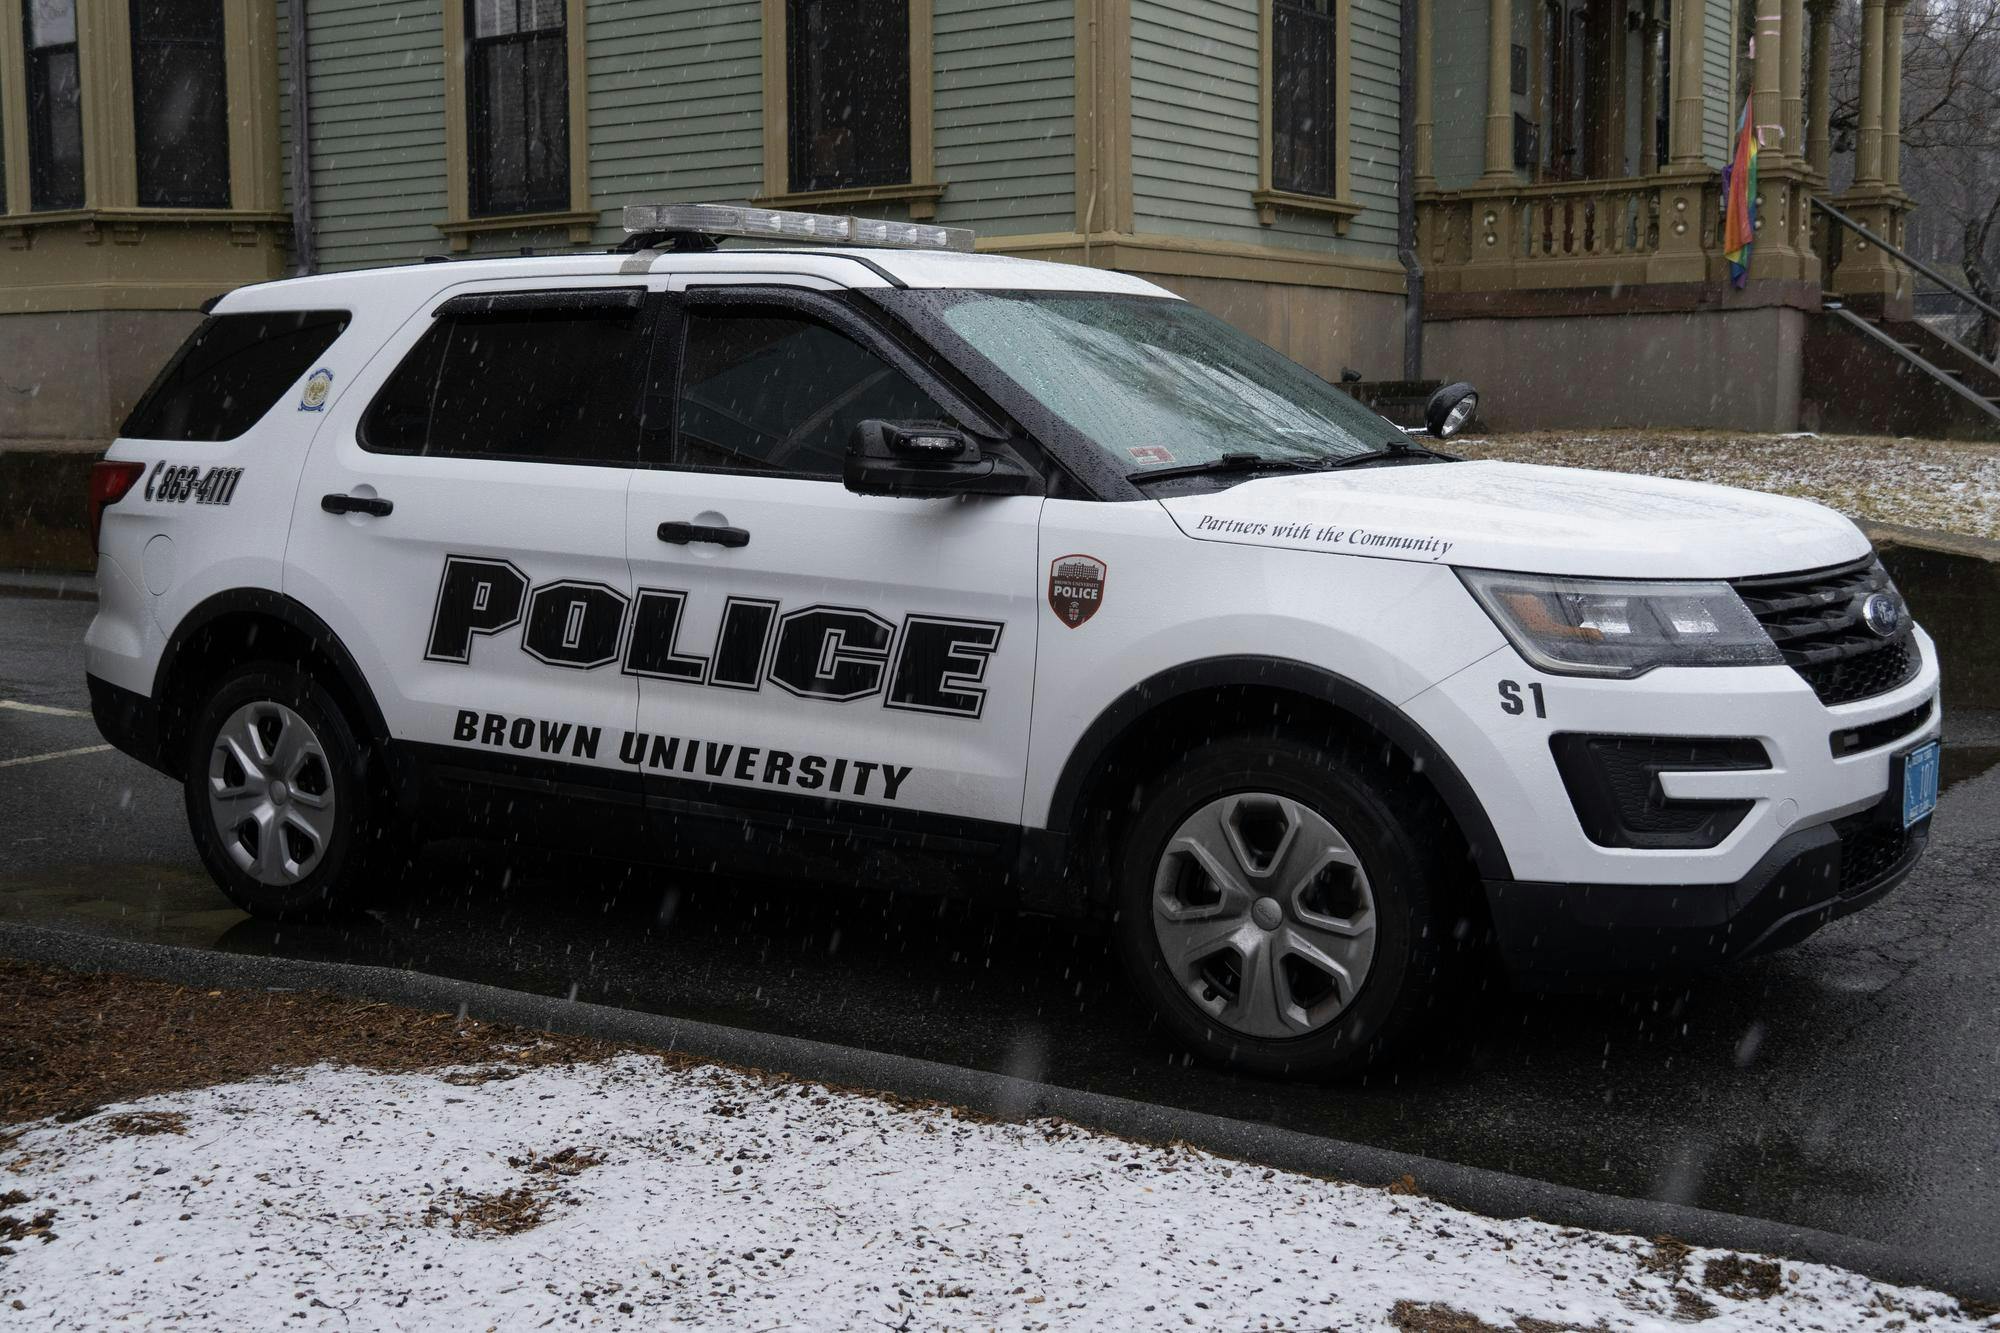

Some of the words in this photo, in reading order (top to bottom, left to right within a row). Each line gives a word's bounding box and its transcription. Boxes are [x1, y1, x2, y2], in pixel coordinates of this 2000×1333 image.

[156, 465, 245, 506] 863-4111
[1196, 514, 1268, 537] Partners
[1271, 522, 1312, 540] with
[1316, 525, 1345, 543] the
[1348, 528, 1453, 561] Community
[1053, 585, 1099, 600] POLICE
[423, 553, 1005, 720] POLICE
[1497, 679, 1547, 719] S1
[453, 709, 602, 759] BROWN
[618, 731, 912, 801] UNIVERSITY
